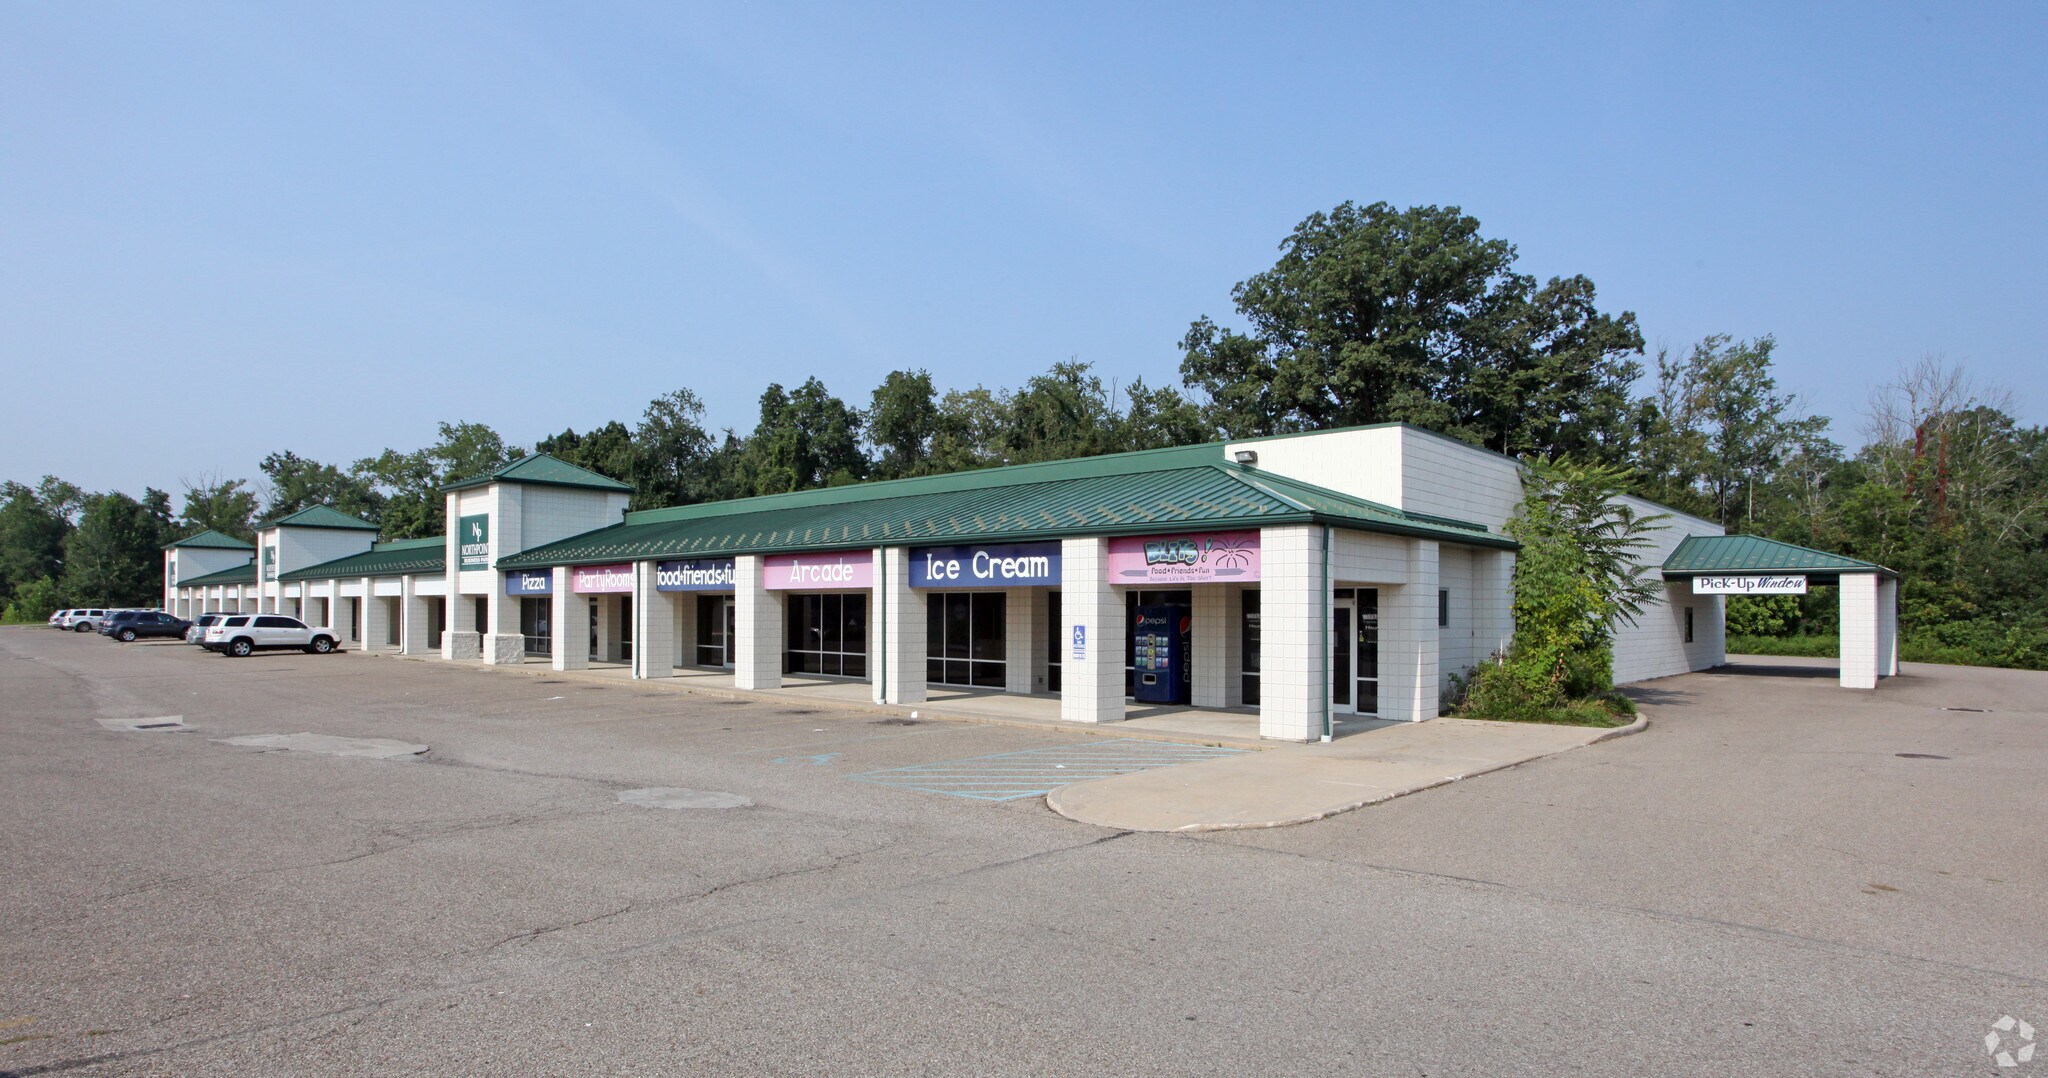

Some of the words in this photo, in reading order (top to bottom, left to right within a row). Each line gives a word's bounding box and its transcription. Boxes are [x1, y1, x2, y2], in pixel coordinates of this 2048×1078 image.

[724, 563, 736, 585] fu
[790, 558, 854, 583] Arcade
[927, 553, 961, 580] Ice
[972, 550, 1049, 579] Cream
[522, 573, 545, 590] Pizza
[1757, 576, 1805, 589] Window
[1145, 617, 1167, 625] pepsi
[1182, 641, 1190, 683] pepsi
